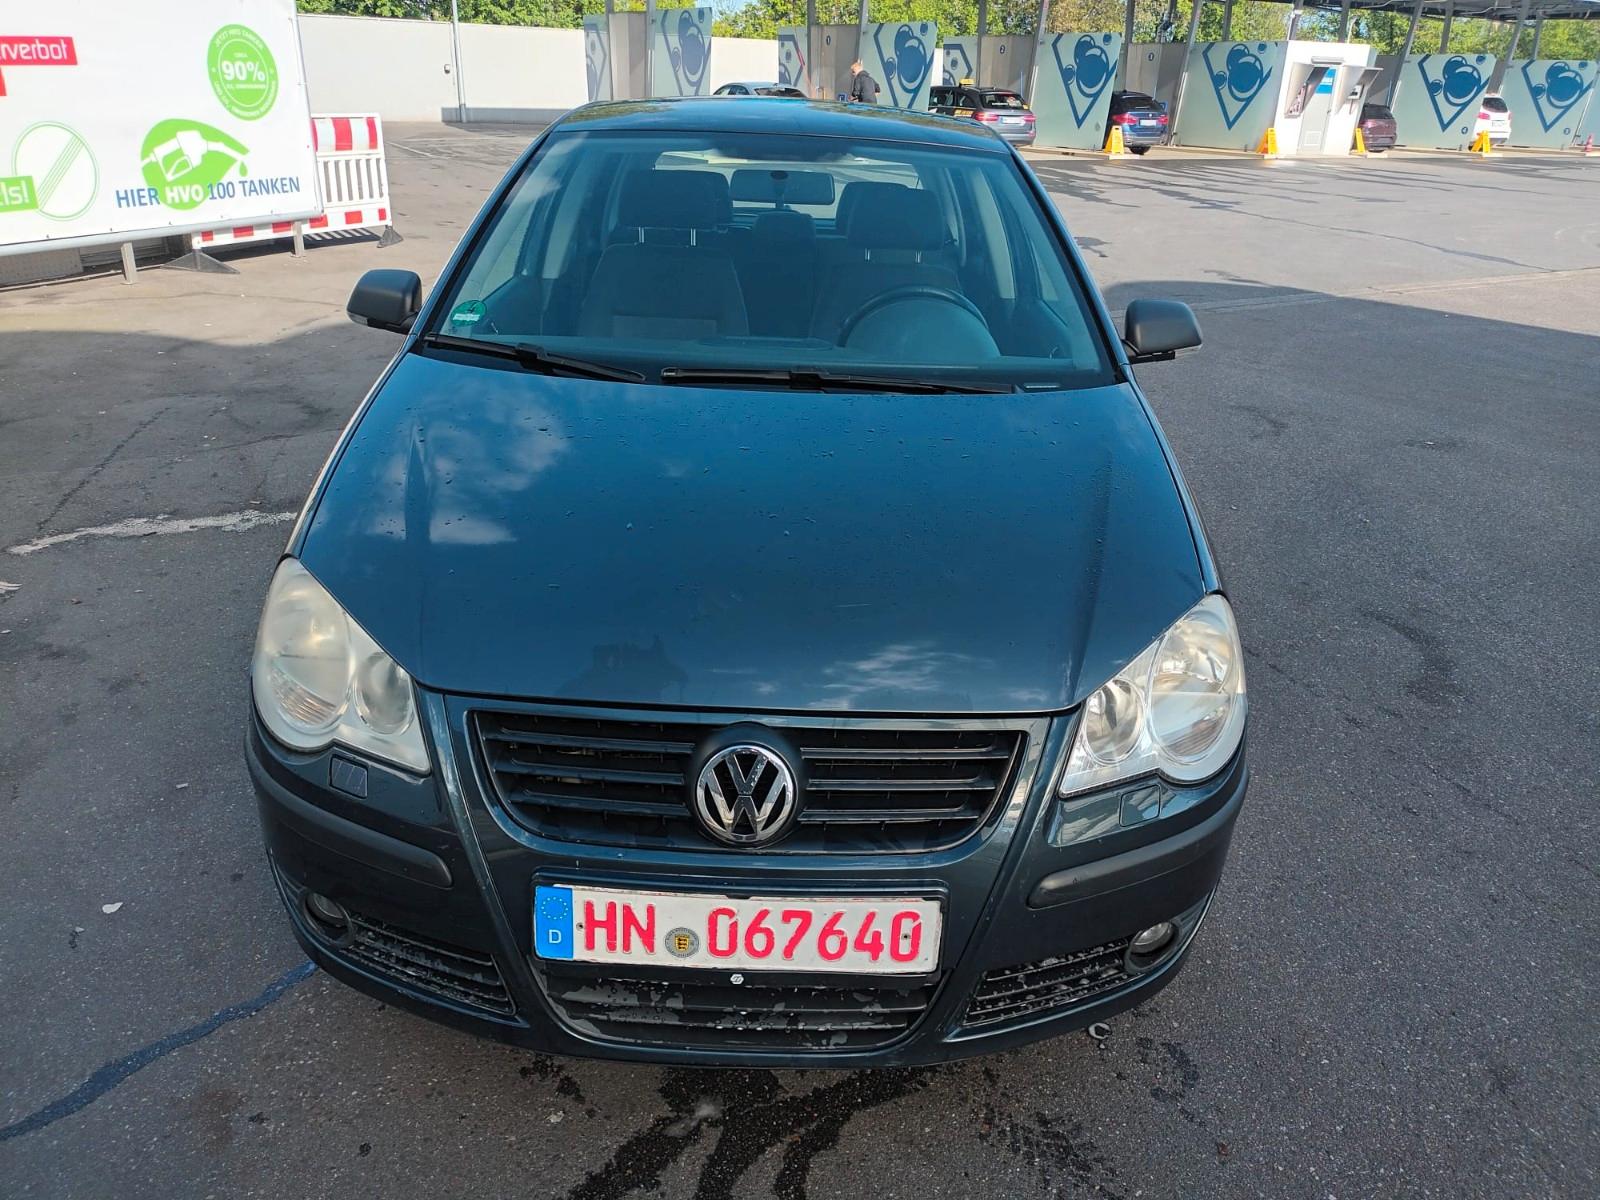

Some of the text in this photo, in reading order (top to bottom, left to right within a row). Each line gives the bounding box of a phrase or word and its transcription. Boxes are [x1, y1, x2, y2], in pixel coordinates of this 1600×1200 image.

[0, 38, 67, 60] rverbot
[222, 60, 266, 81] 90%
[115, 176, 301, 209] HIER HVO 100 TANKEN
[697, 746, 793, 841] VW
[548, 929, 562, 945] D
[583, 900, 656, 953] HN
[707, 907, 922, 962] 067640
